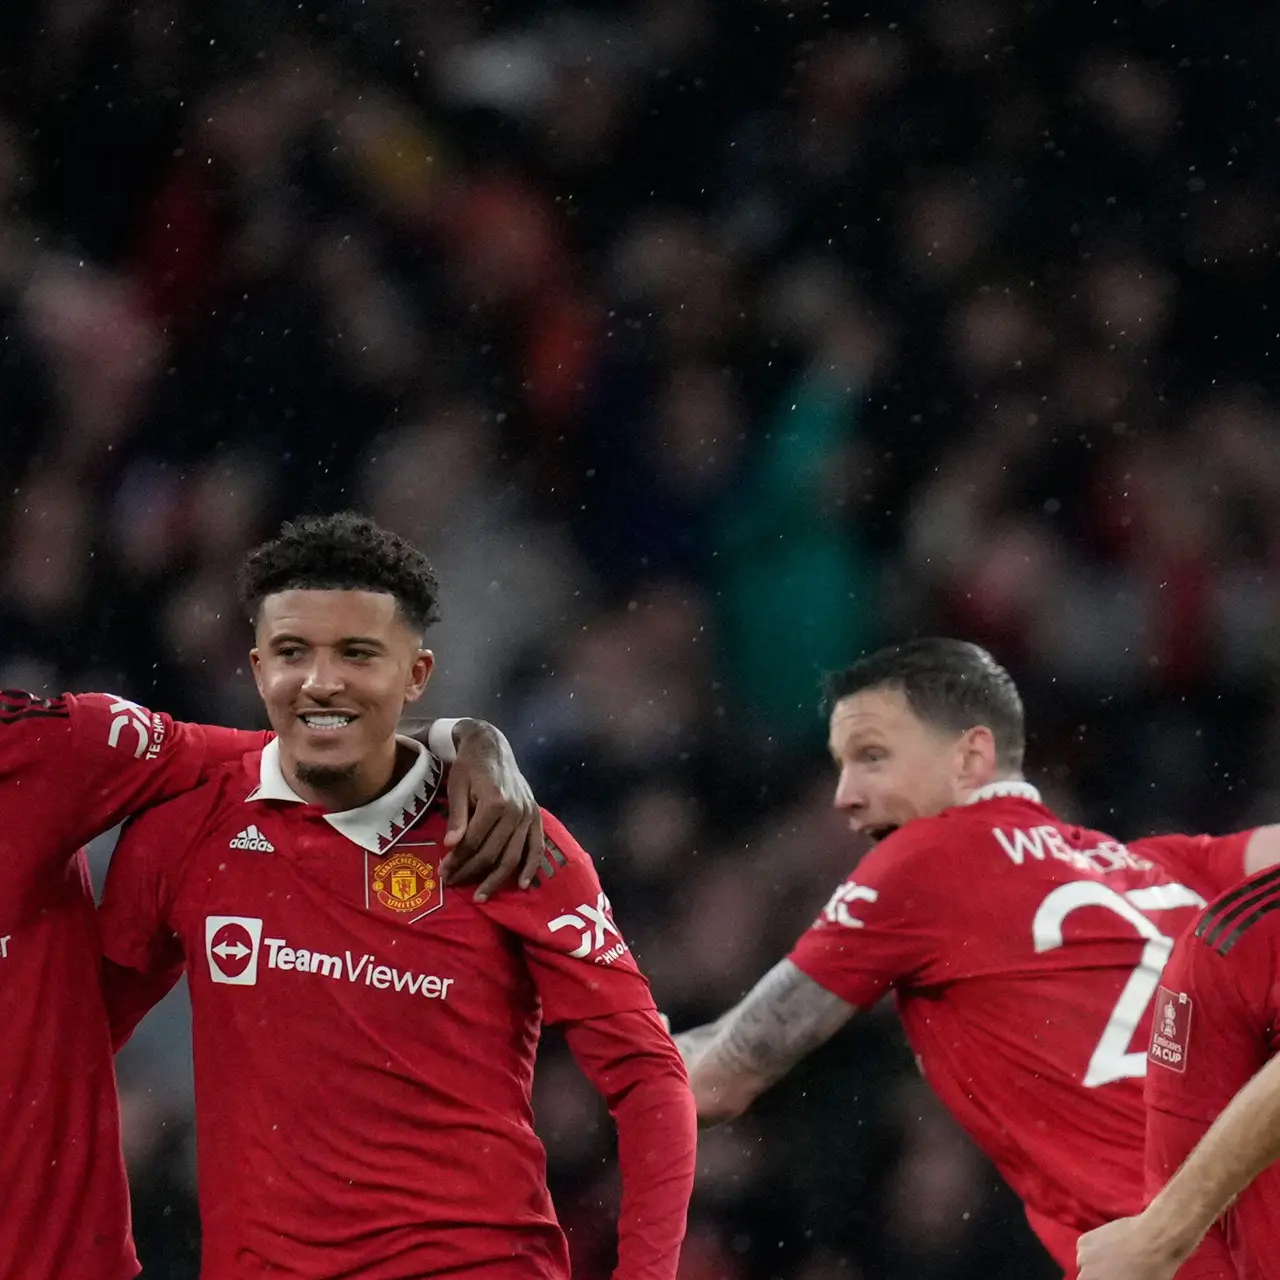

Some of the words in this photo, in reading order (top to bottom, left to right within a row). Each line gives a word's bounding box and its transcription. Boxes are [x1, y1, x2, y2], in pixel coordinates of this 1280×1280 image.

[229, 836, 275, 853] adidas
[379, 857, 429, 876] MANCHESTER
[387, 897, 422, 908] UNITED
[264, 938, 455, 1000] TeamViewer
[1162, 1048, 1182, 1063] CUP
